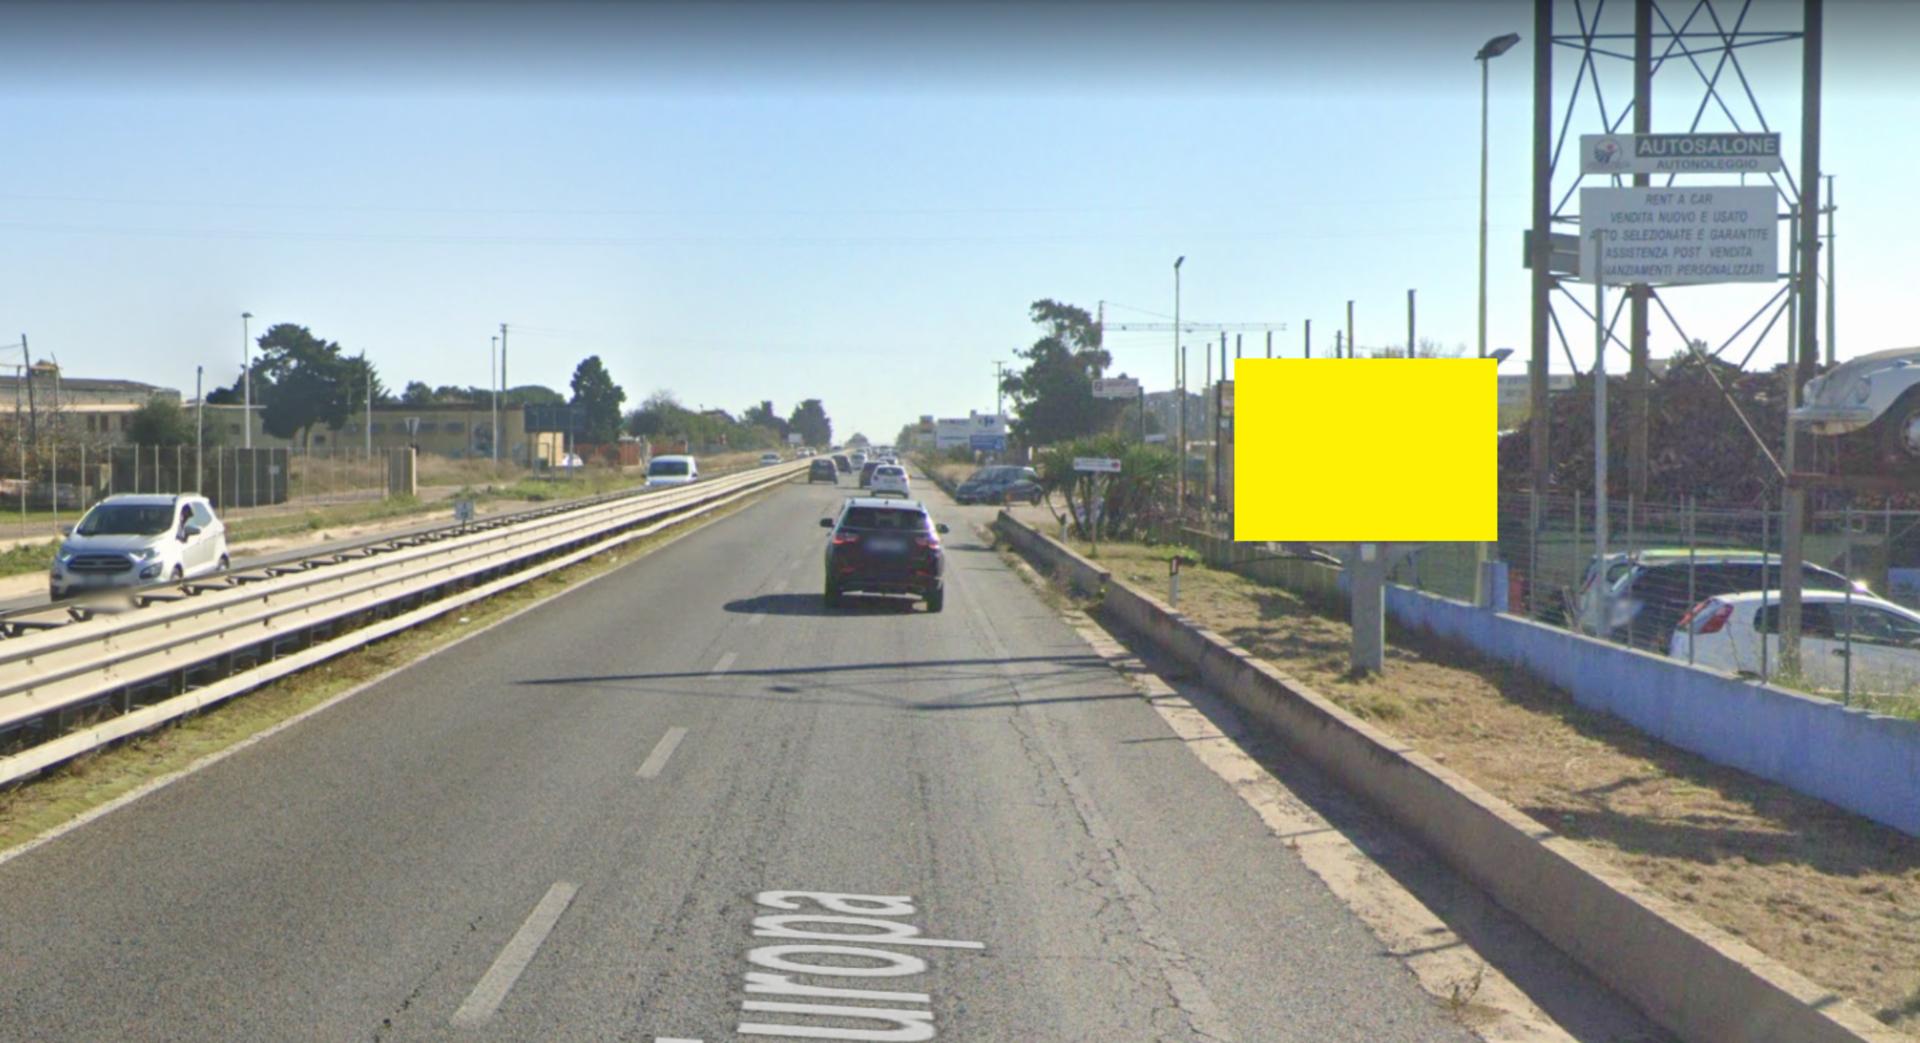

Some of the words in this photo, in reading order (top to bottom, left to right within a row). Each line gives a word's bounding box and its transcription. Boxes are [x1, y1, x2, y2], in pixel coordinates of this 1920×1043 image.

[1638, 137, 1777, 154] AUTOSALONE
[1656, 159, 1758, 169] AUTONOLEGGIO
[1645, 194, 1672, 205] RENT
[1677, 194, 1687, 204] A
[1690, 193, 1713, 204] CAR
[1610, 212, 1653, 223] VENDITA
[1658, 211, 1696, 223] NUOVO
[1700, 211, 1708, 222] E
[1712, 211, 1748, 222] USATO
[1623, 229, 1692, 241] SELEZIONATE
[1697, 229, 1706, 240] E
[1710, 228, 1769, 240] GARANTITE
[1605, 247, 1668, 258] ASSISTENZA
[1672, 246, 1702, 257] POST
[1709, 246, 1753, 258] VENDITA
[1677, 264, 1764, 275] PERSONALIZZATI
